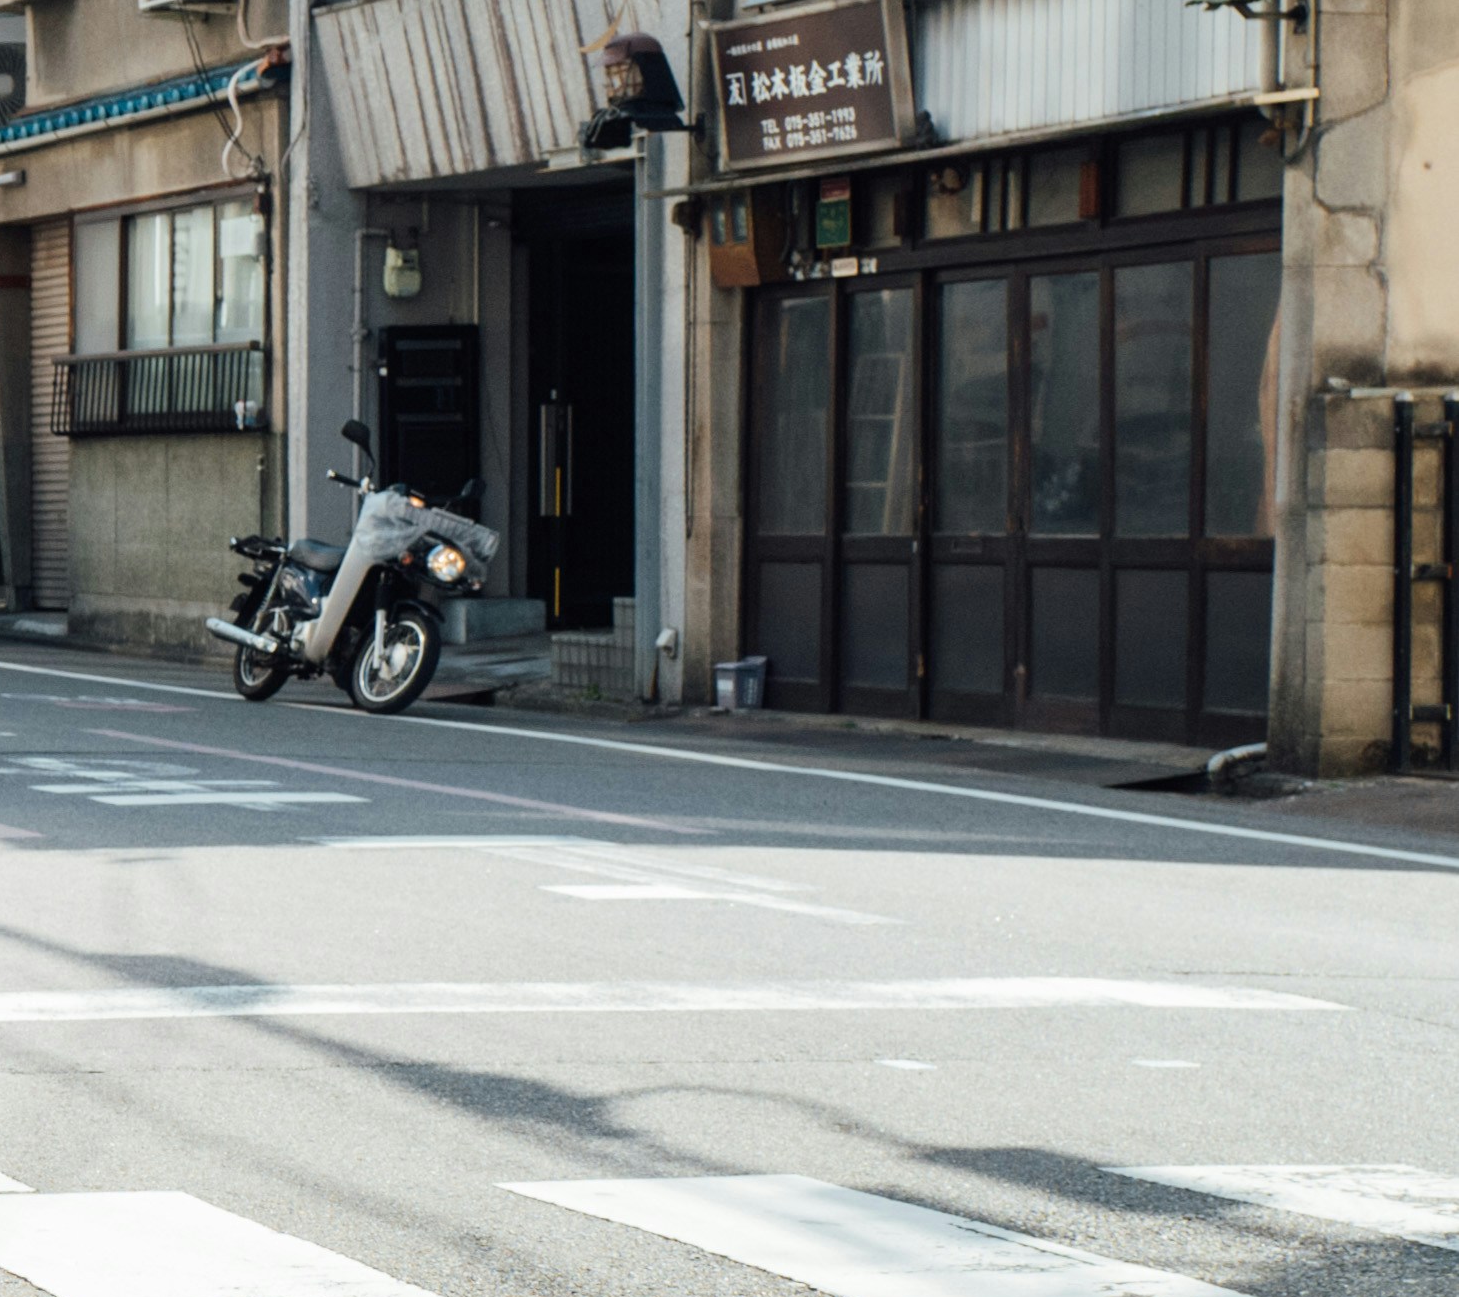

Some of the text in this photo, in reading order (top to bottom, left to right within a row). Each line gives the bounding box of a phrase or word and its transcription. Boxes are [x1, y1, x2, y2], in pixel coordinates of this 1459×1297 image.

[752, 50, 884, 104] 松本板金工業所
[760, 118, 780, 134] TEL
[762, 135, 782, 151] FAX
